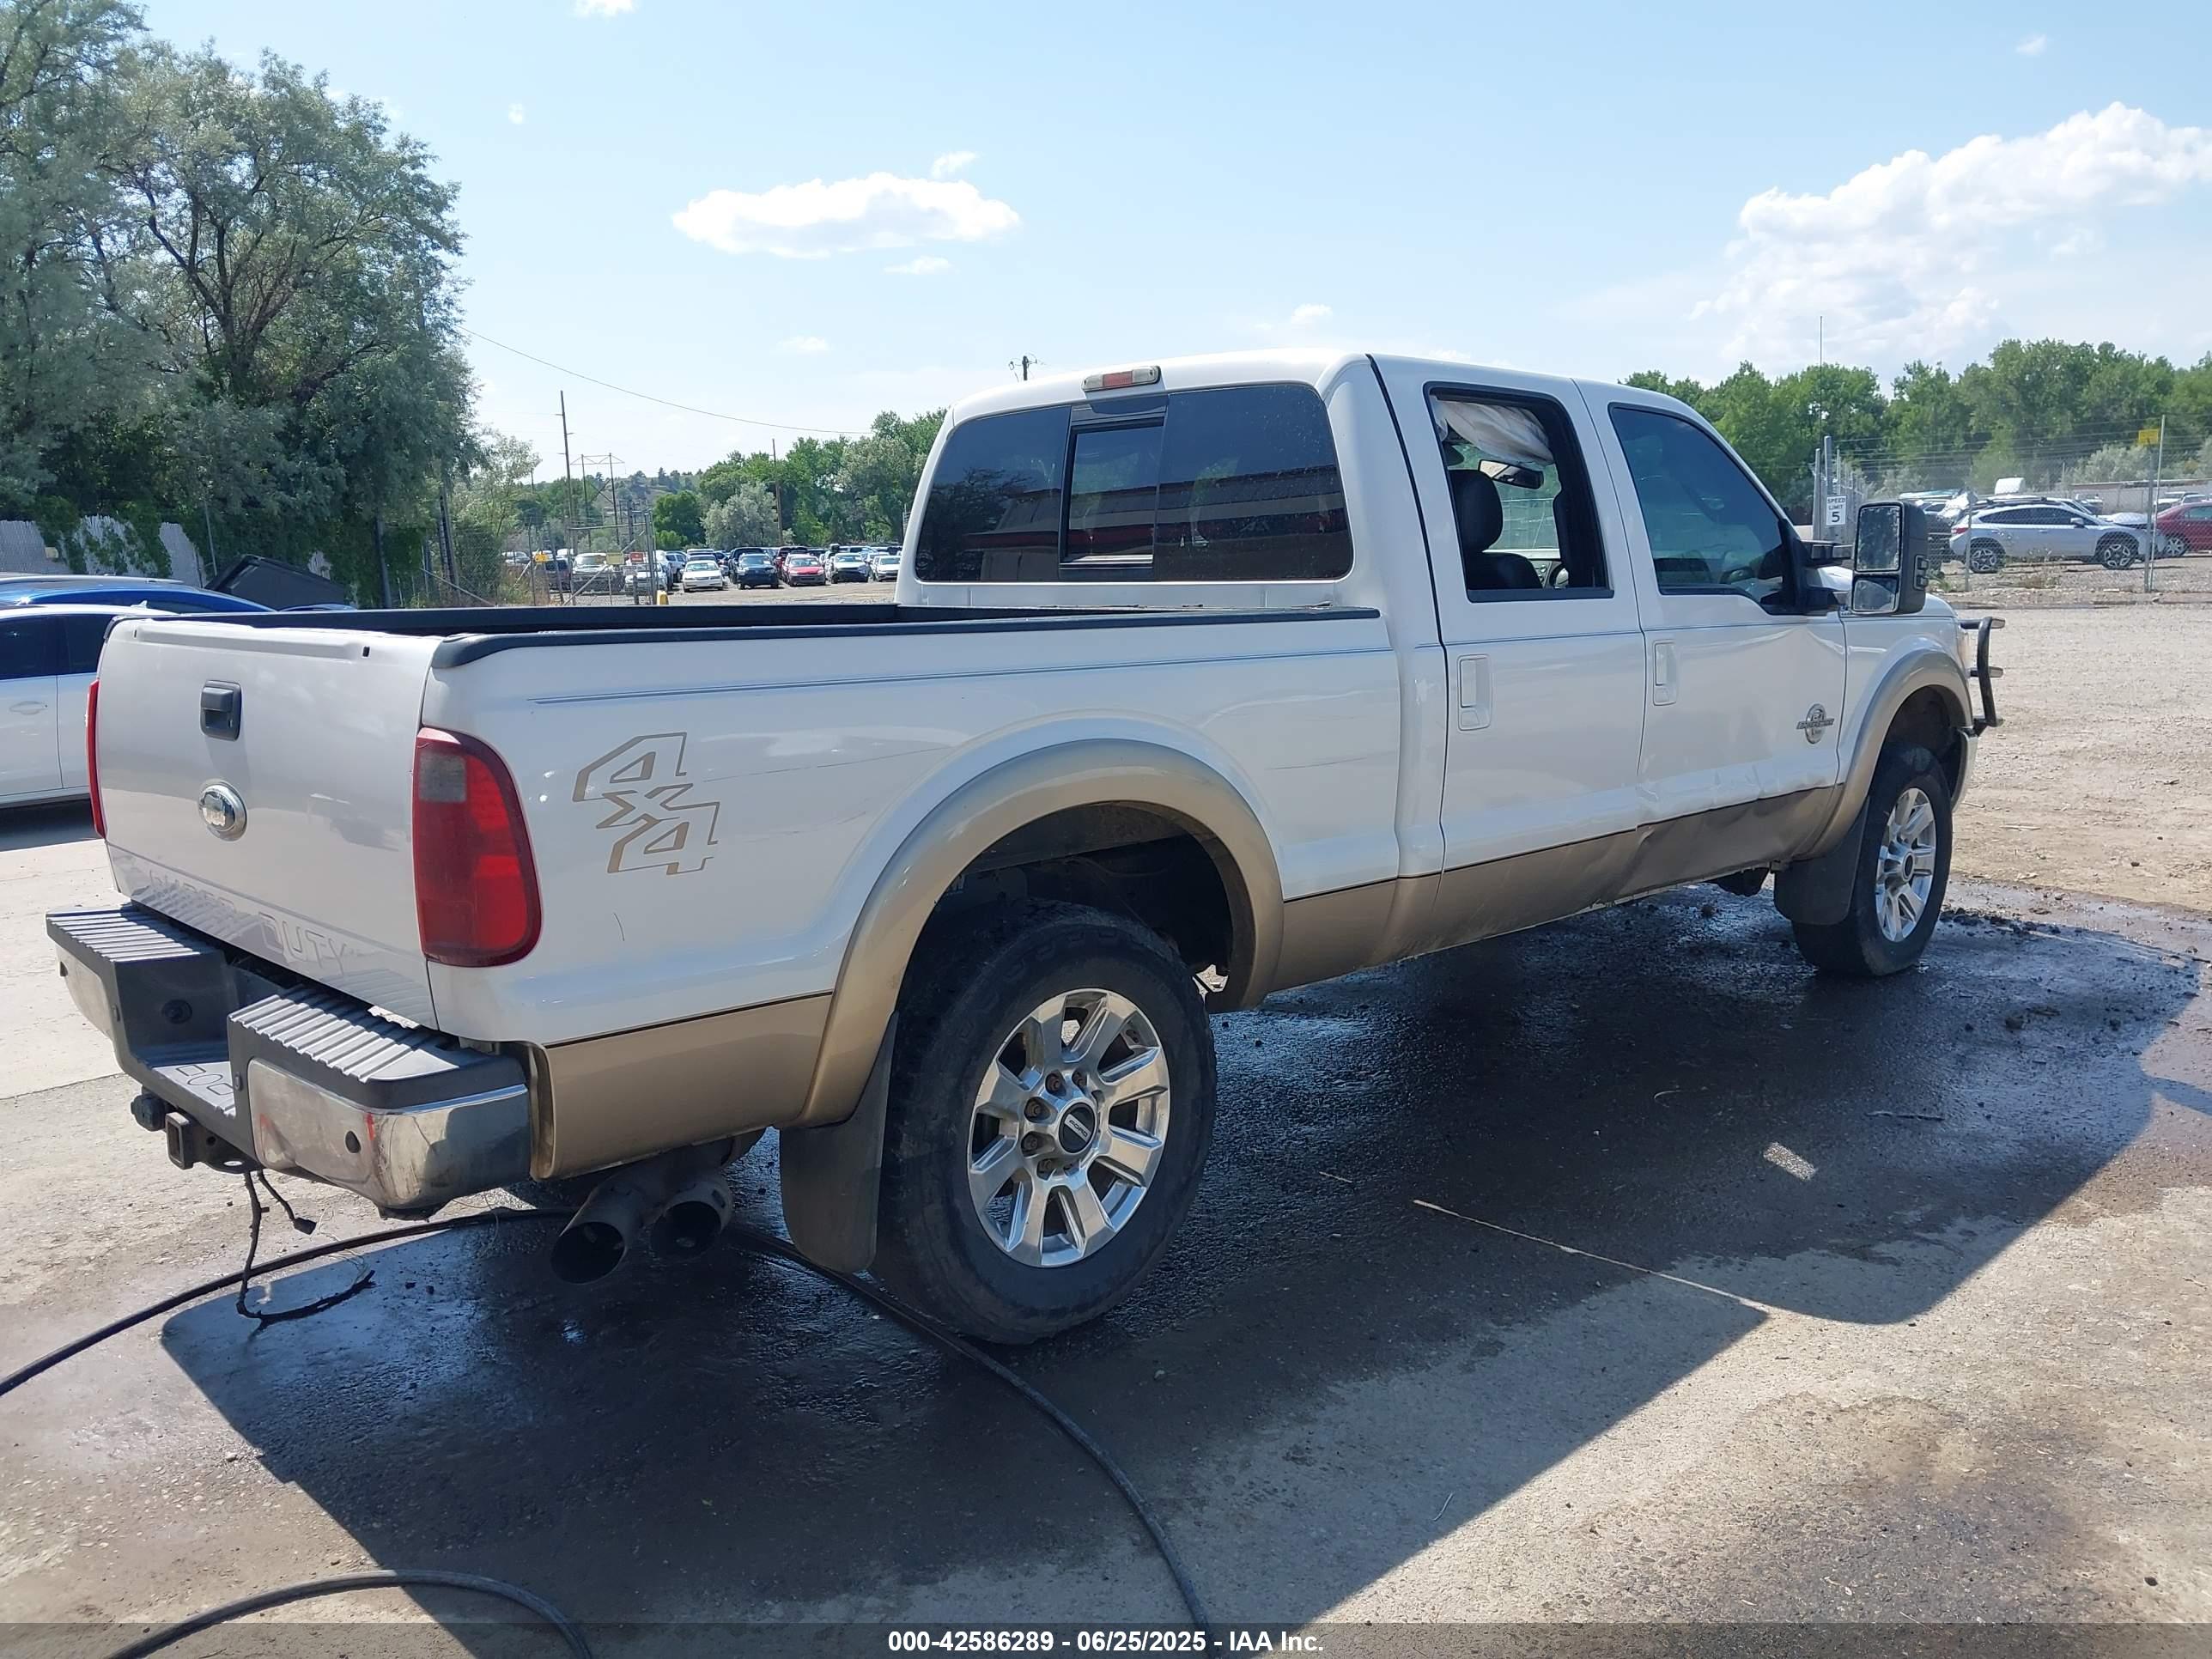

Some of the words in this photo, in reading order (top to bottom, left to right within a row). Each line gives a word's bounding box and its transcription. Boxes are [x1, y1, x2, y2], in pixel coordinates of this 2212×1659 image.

[1832, 511, 1840, 523] 5
[258, 911, 348, 975] DUTY
[1068, 1119, 1088, 1139] FORD
